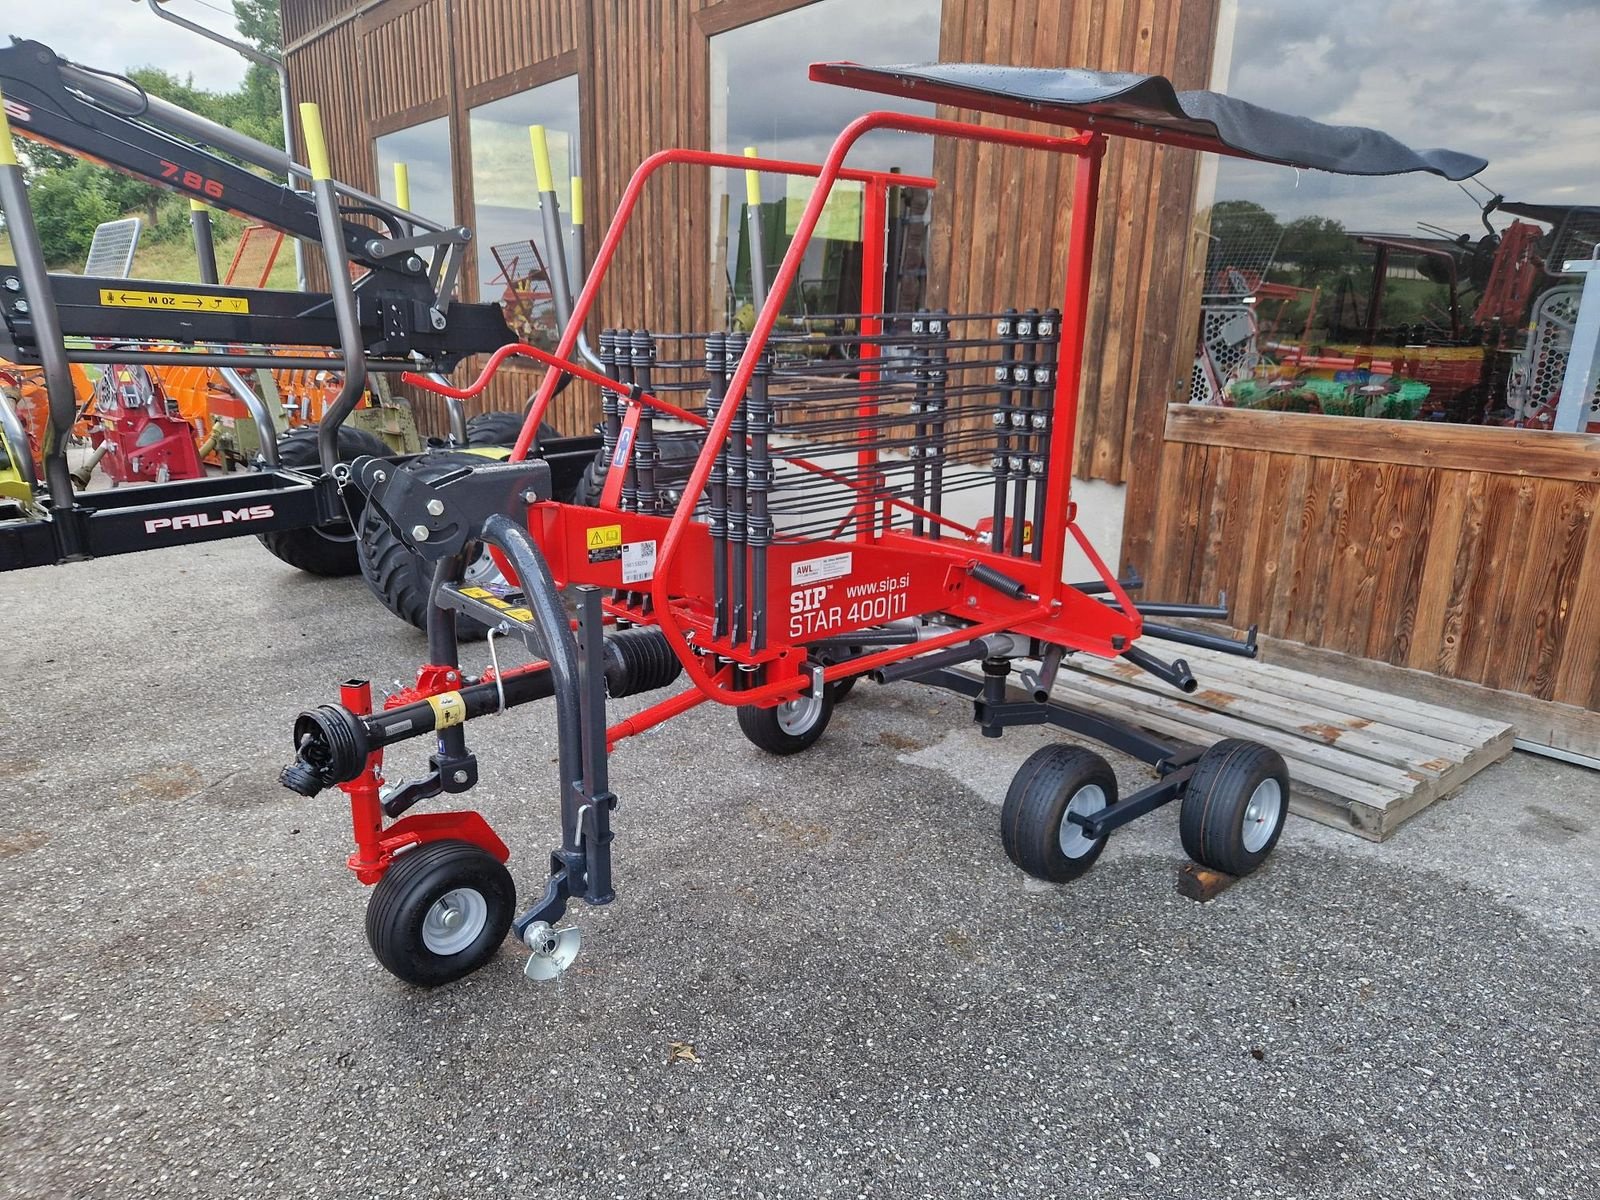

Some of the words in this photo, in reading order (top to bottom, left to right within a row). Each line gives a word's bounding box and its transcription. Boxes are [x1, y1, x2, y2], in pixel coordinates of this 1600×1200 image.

[160, 160, 224, 198] 7.86
[148, 296, 158, 304] M
[162, 297, 176, 305] 20
[144, 504, 275, 534] PALMS
[796, 564, 813, 576] AWL
[846, 572, 910, 599] www.sip.si
[789, 586, 827, 614] SIP
[789, 606, 842, 638] STAR
